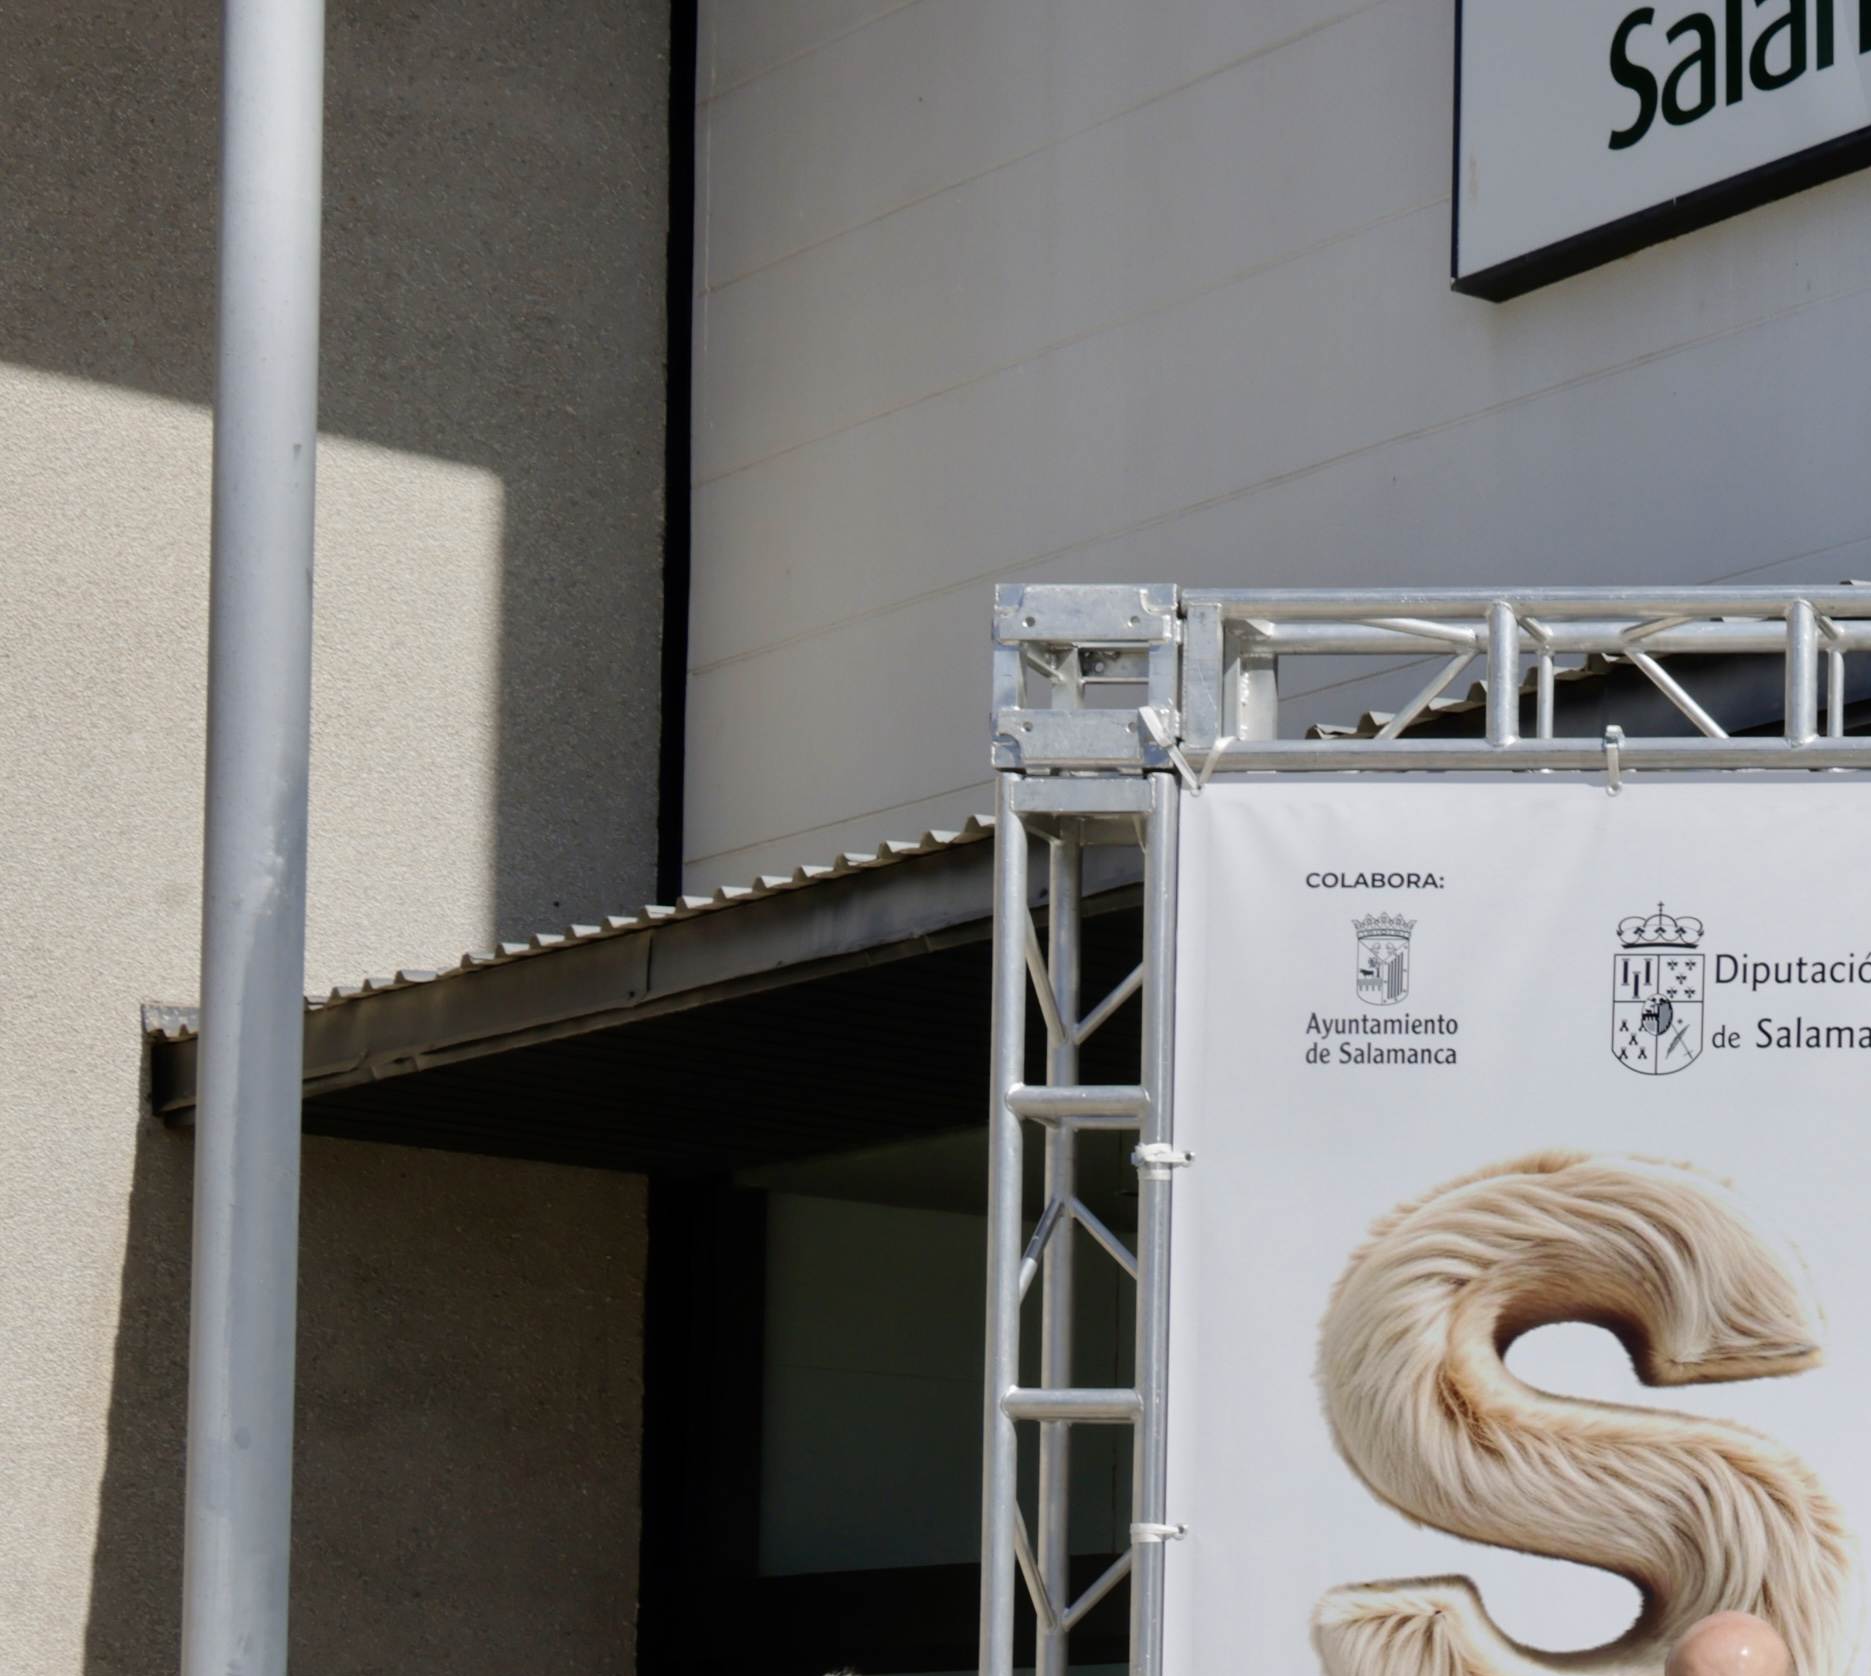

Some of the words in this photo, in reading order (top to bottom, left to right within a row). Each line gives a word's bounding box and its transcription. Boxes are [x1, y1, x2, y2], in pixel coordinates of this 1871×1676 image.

[1306, 872, 1445, 889] COLABORA:
[1305, 1012, 1458, 1039] Ayuntamiento
[1712, 1024, 1740, 1049] de
[1305, 1042, 1331, 1064] de
[1339, 1042, 1457, 1064] Salamanca
